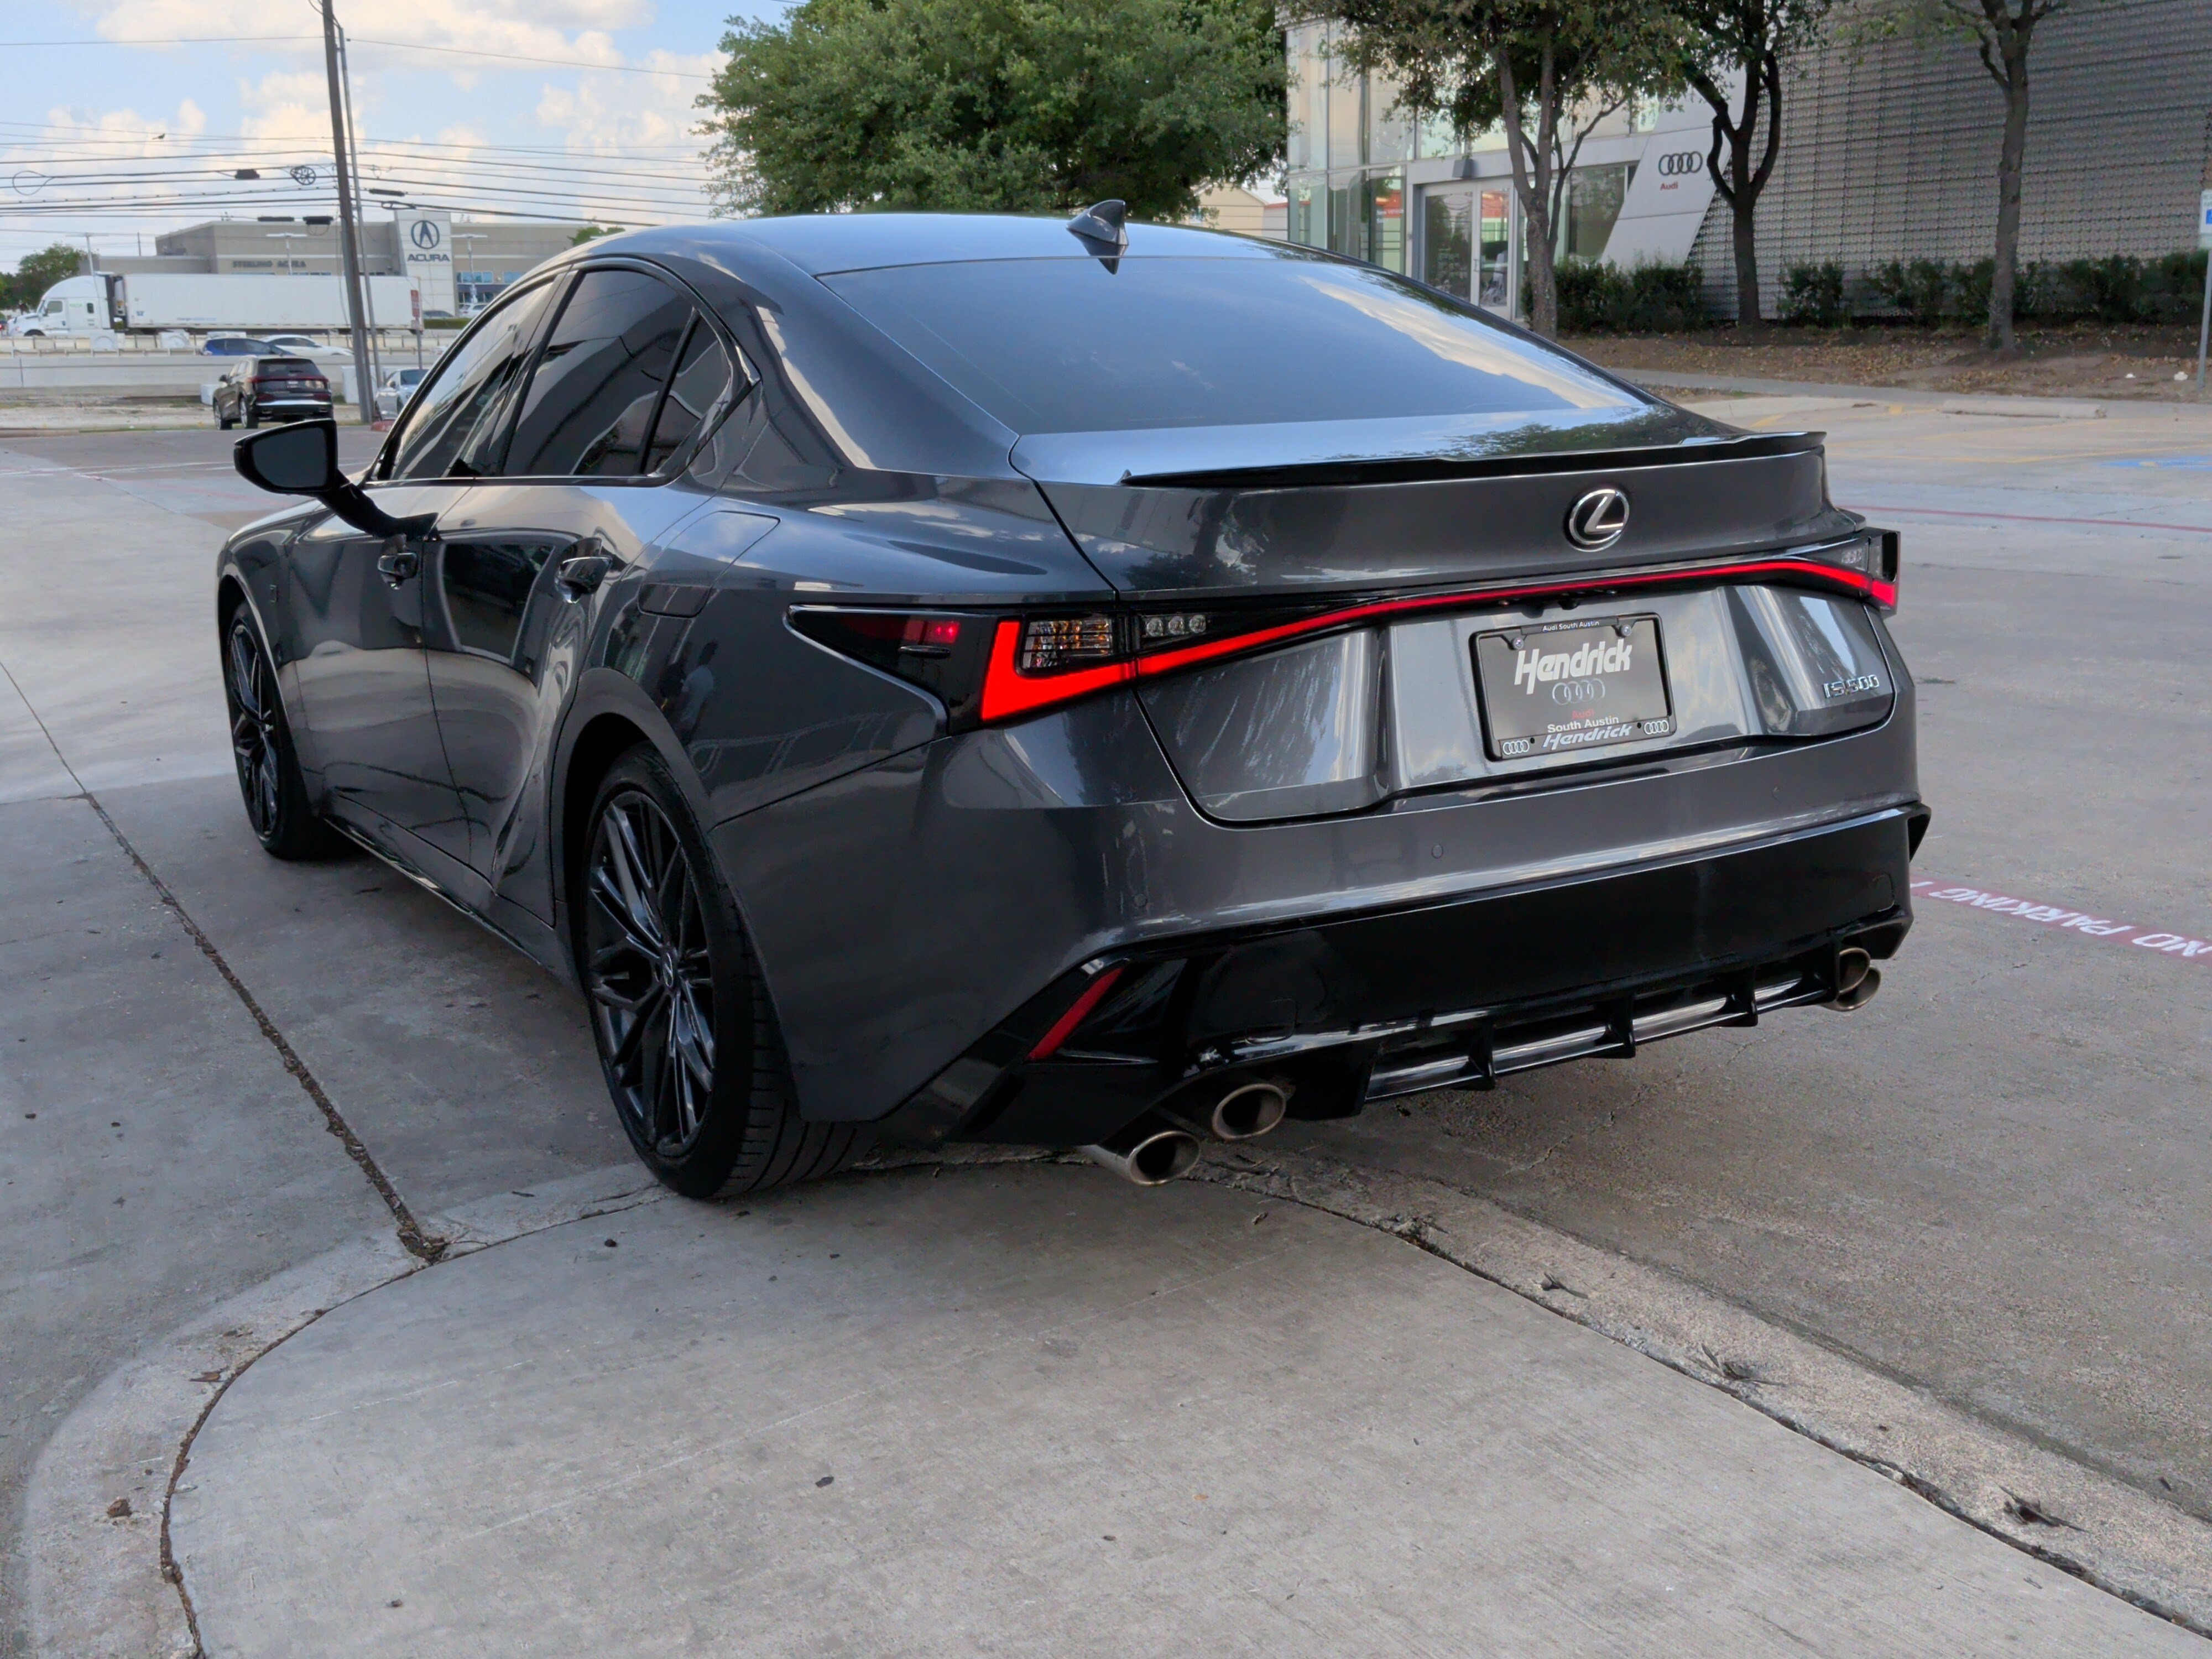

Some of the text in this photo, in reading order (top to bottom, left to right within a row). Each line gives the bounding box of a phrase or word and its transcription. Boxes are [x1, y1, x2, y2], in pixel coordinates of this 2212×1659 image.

[1660, 181, 1678, 191] Audi
[1514, 638, 1632, 695] Hendrick
[1547, 715, 1619, 733] South Austin
[1572, 708, 1595, 719] Audi
[1542, 723, 1633, 750] Hendrick
[1928, 888, 2212, 957] NO PARKING
